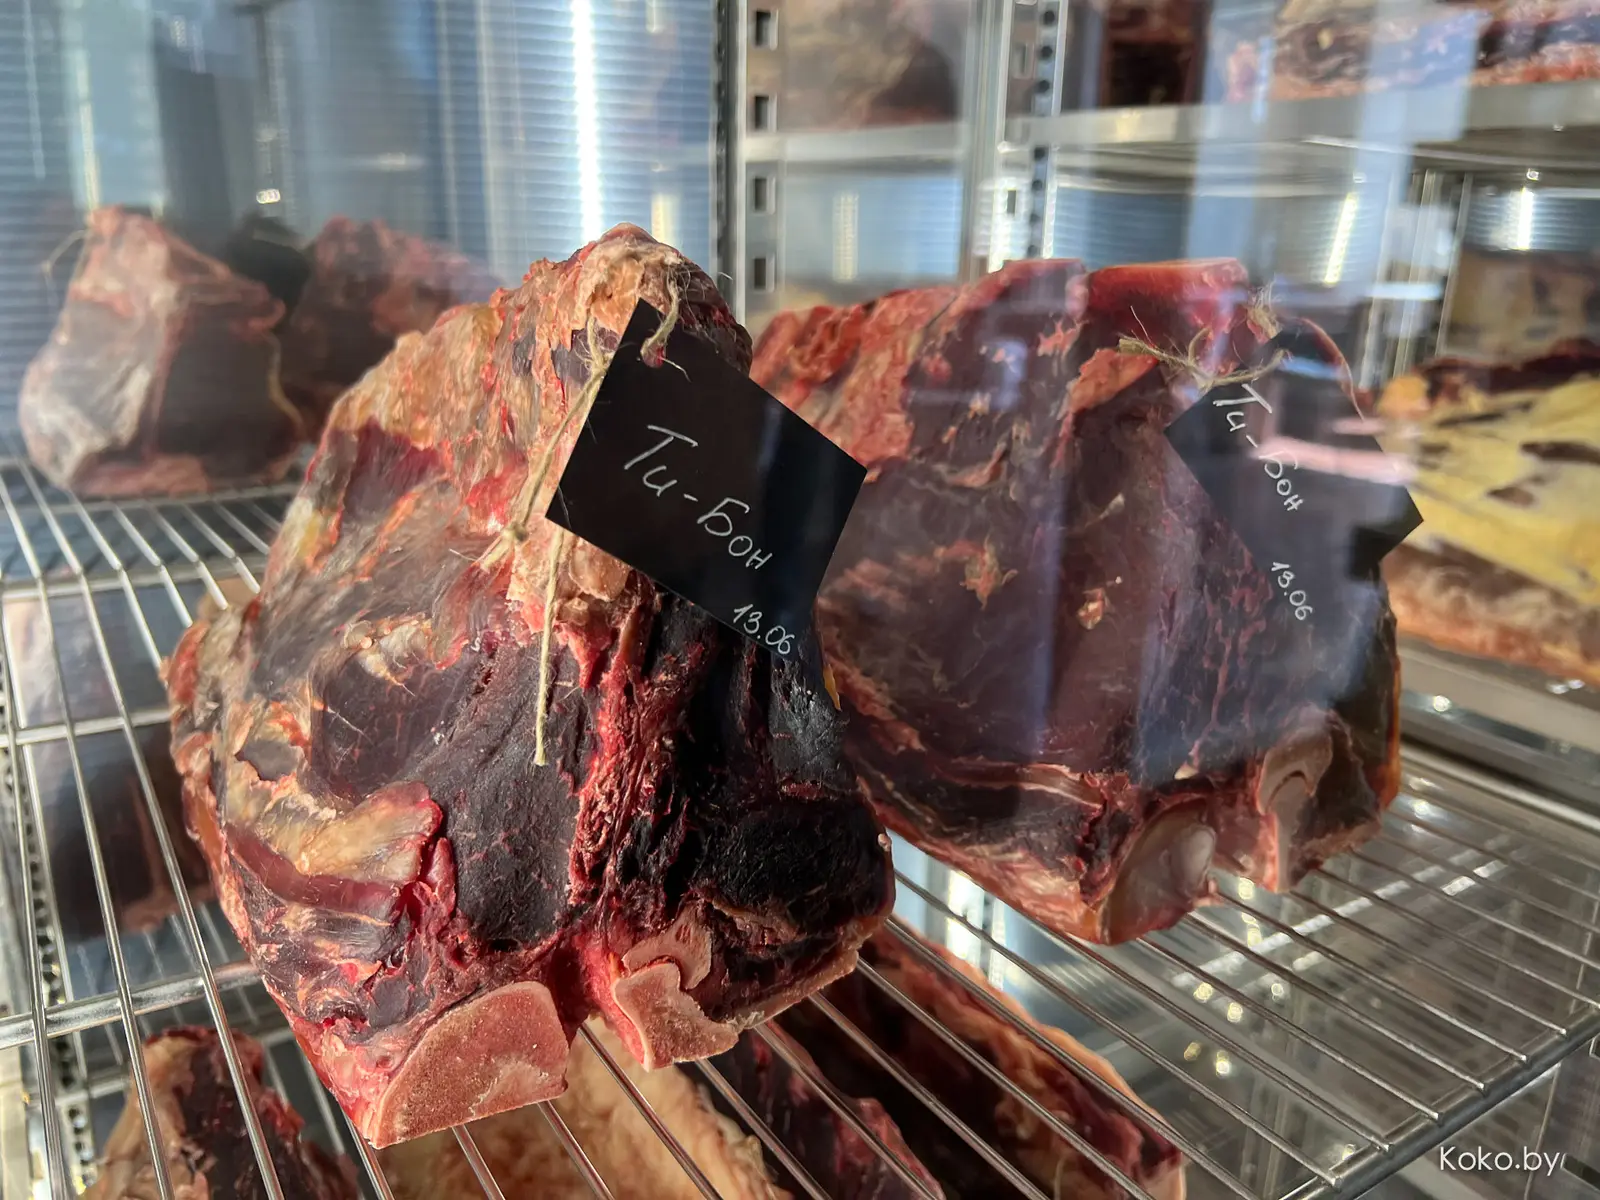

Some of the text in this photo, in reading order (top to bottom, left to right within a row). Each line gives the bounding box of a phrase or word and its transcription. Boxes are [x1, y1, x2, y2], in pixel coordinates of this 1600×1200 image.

[623, 424, 773, 570] Ти-Бон
[1270, 560, 1314, 621] 13.06
[732, 603, 796, 655] 13.06
